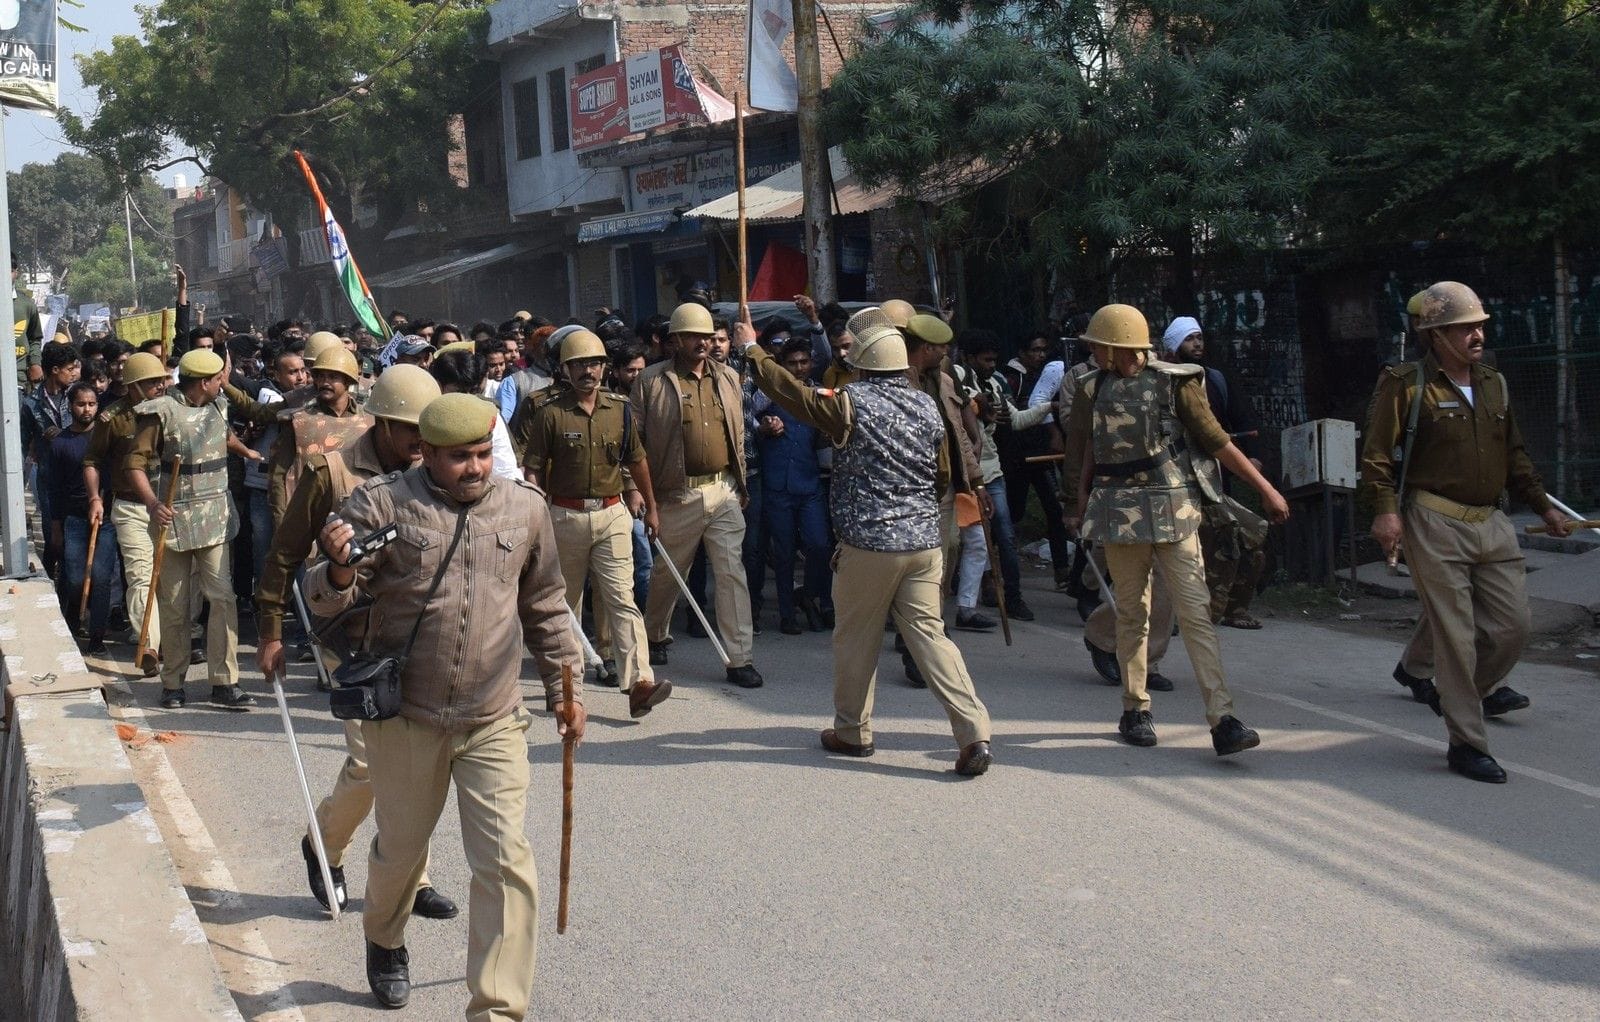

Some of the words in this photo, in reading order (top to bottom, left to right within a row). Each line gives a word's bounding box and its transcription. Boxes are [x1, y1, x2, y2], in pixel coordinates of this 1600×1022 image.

[13, 44, 31, 58] IN
[0, 61, 52, 77] GARH
[629, 69, 659, 90] SHYAM
[629, 94, 640, 106] LAL
[645, 88, 662, 101] SONS
